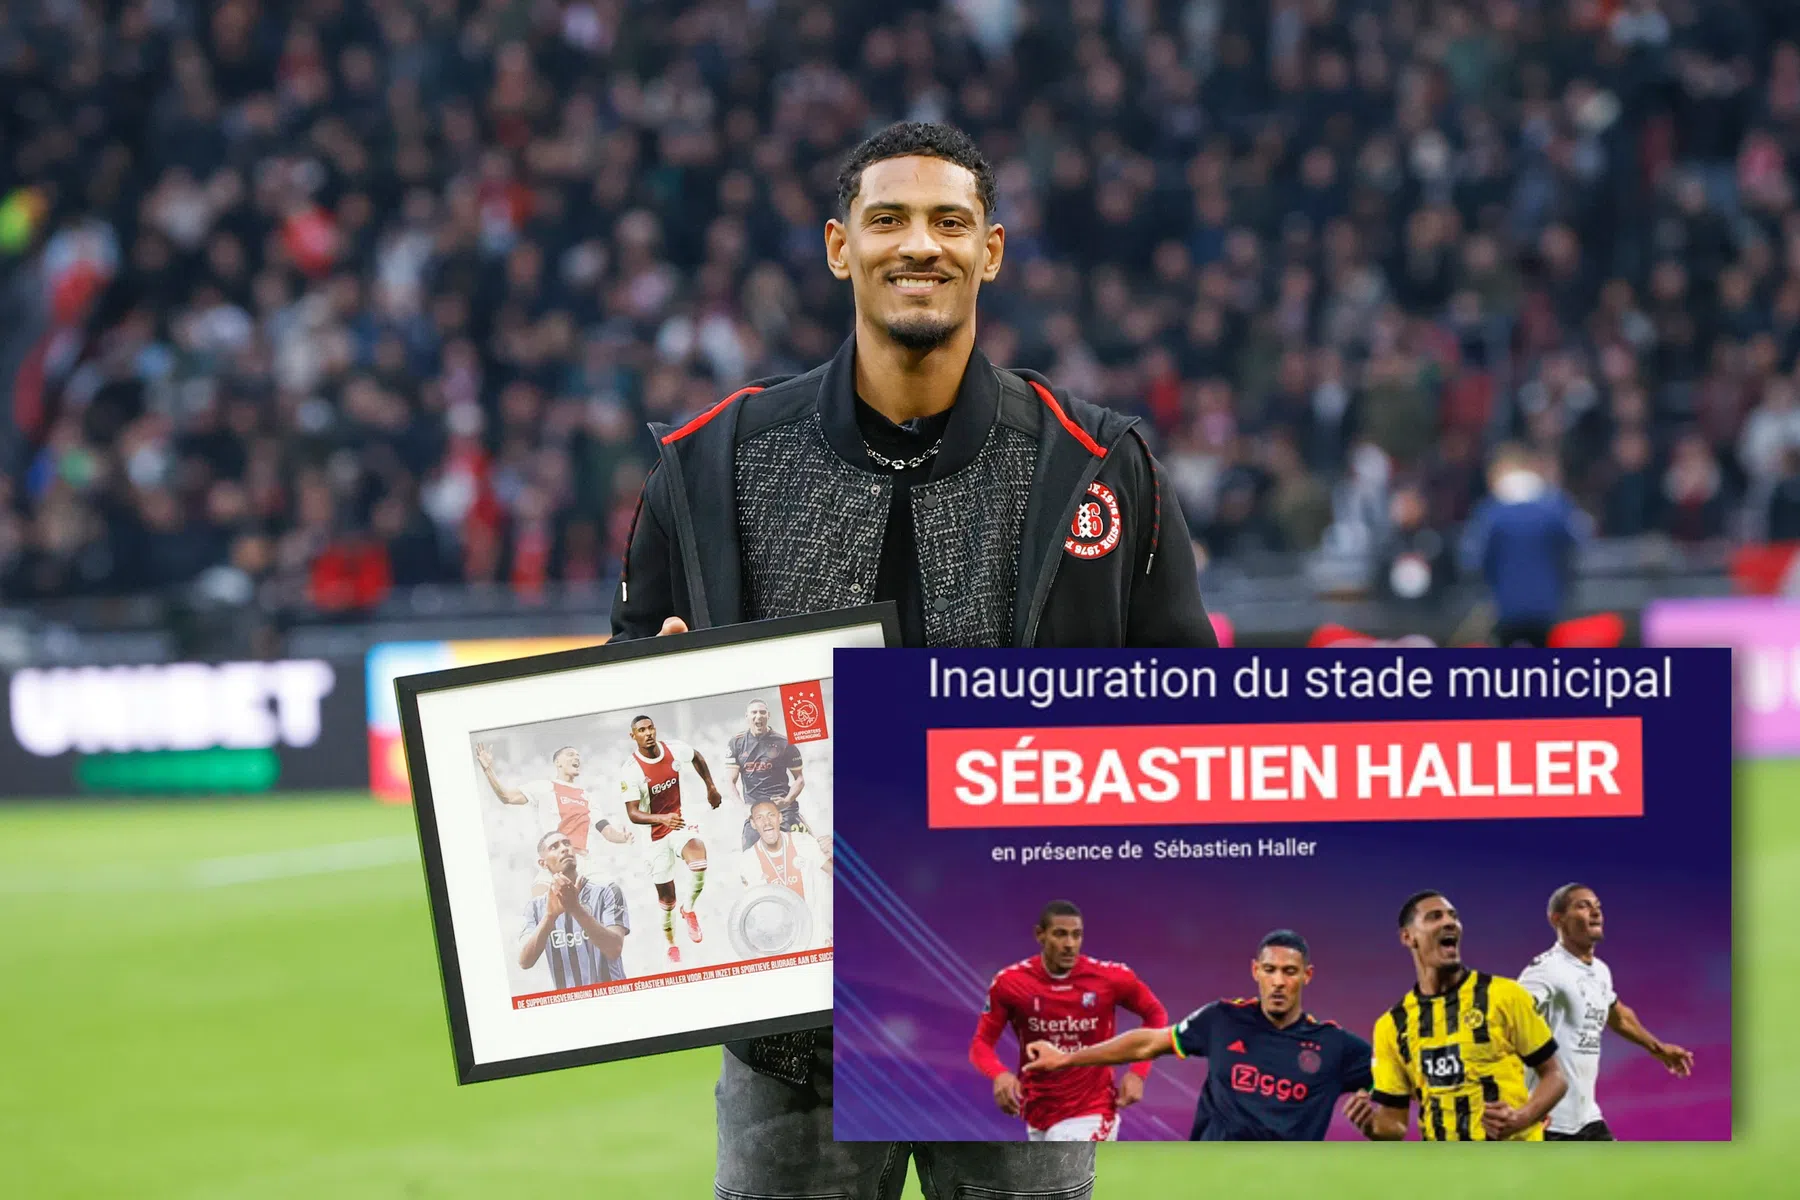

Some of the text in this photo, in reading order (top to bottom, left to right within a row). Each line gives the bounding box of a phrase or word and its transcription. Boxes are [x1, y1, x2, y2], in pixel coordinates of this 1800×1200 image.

[517, 1000, 527, 1009] DE
[526, 989, 593, 1008] SUPPORTERSVERENIGING
[593, 987, 608, 997] AJAX
[608, 984, 634, 995] BEDANKT
[634, 979, 665, 991] SÉBASTIEN
[665, 975, 687, 986] HALLER
[687, 973, 703, 983] VOOR
[702, 970, 715, 980] ZIJN
[714, 967, 731, 978] INZET
[732, 967, 741, 976] EN
[741, 962, 771, 974] SPORTIEVE
[771, 957, 797, 969] BIJDRAGE
[797, 956, 810, 965] AAN
[810, 954, 818, 963] DE
